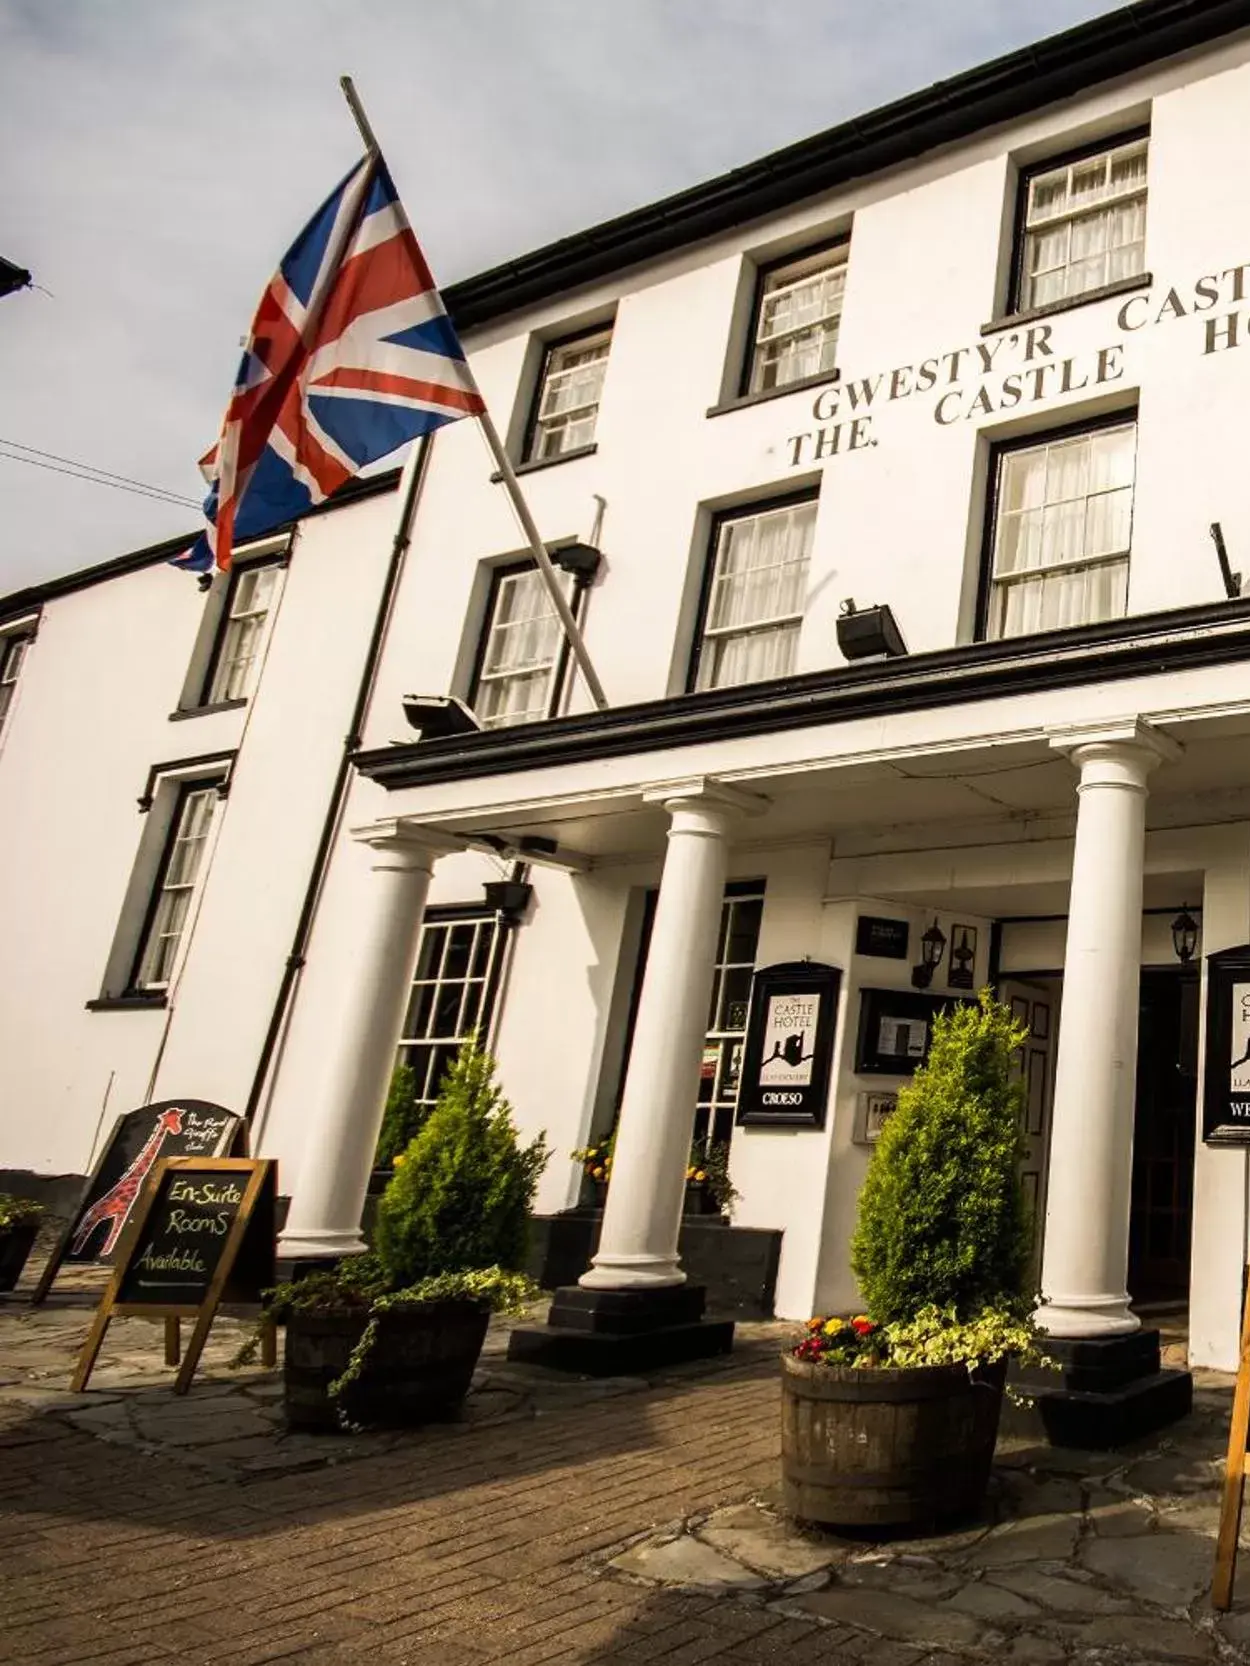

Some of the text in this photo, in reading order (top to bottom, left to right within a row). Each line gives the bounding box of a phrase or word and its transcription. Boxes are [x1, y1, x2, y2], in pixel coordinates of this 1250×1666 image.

[812, 323, 1055, 421] GWESTY'R
[934, 345, 1126, 426] CASTLE
[774, 1004, 814, 1015] CASTLE
[774, 1016, 812, 1028] HOTEL
[762, 1092, 803, 1105] CROESO
[133, 1243, 207, 1272] Available
